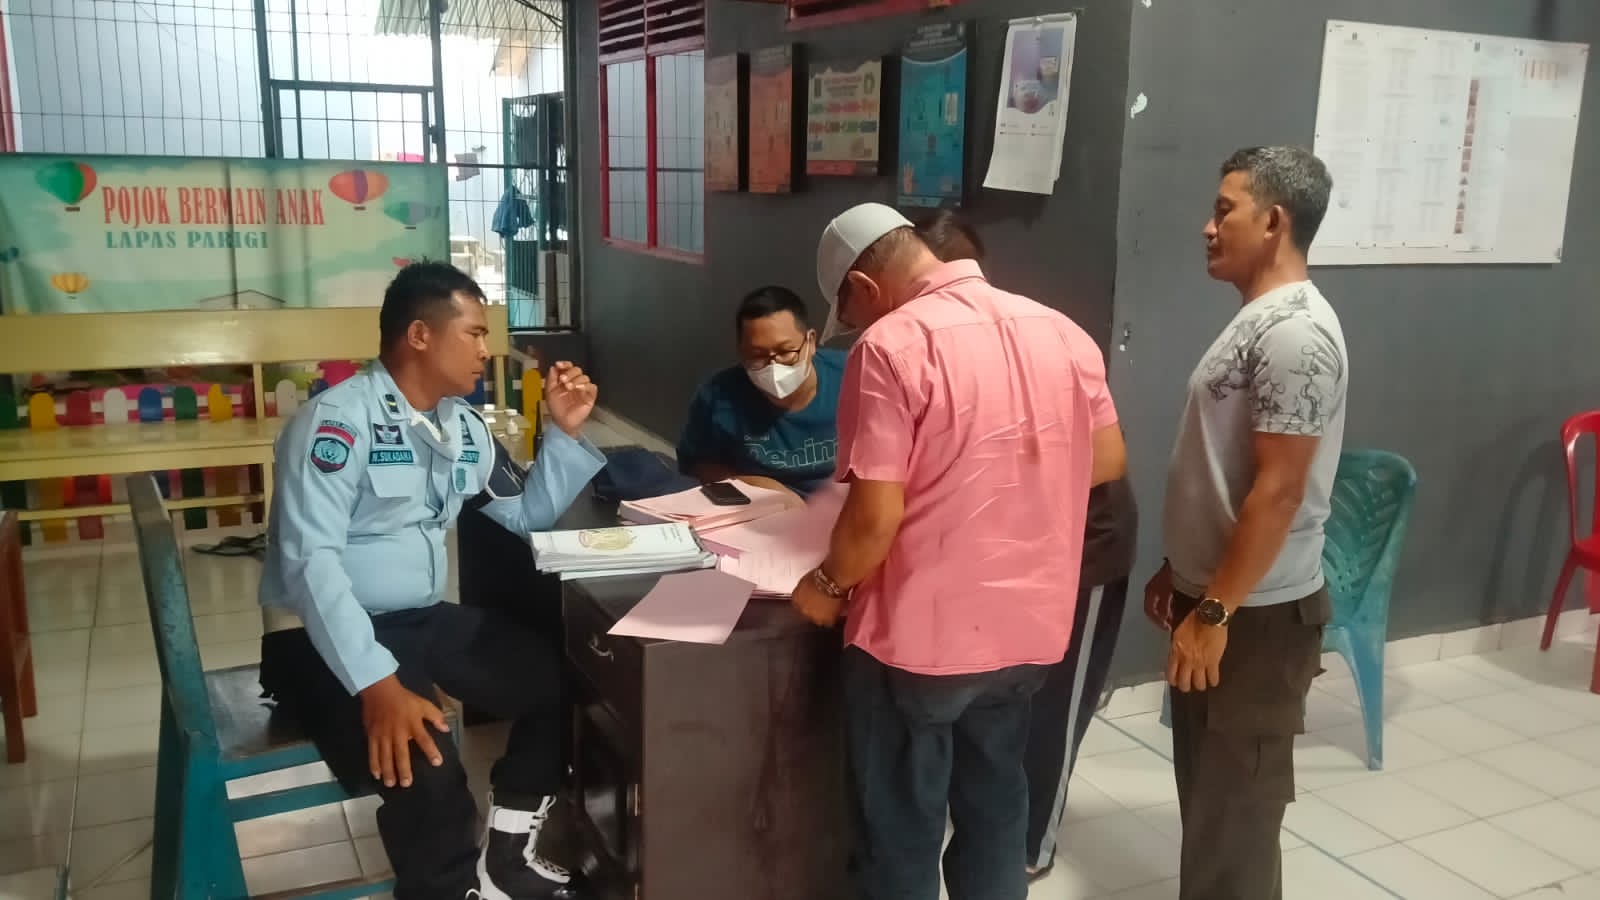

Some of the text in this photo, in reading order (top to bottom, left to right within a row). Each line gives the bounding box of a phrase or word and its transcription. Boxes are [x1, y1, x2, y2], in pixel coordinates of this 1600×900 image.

[102, 186, 325, 229] POJOK BERMAIN ANAK
[105, 230, 269, 249] LAPAS PARIGI
